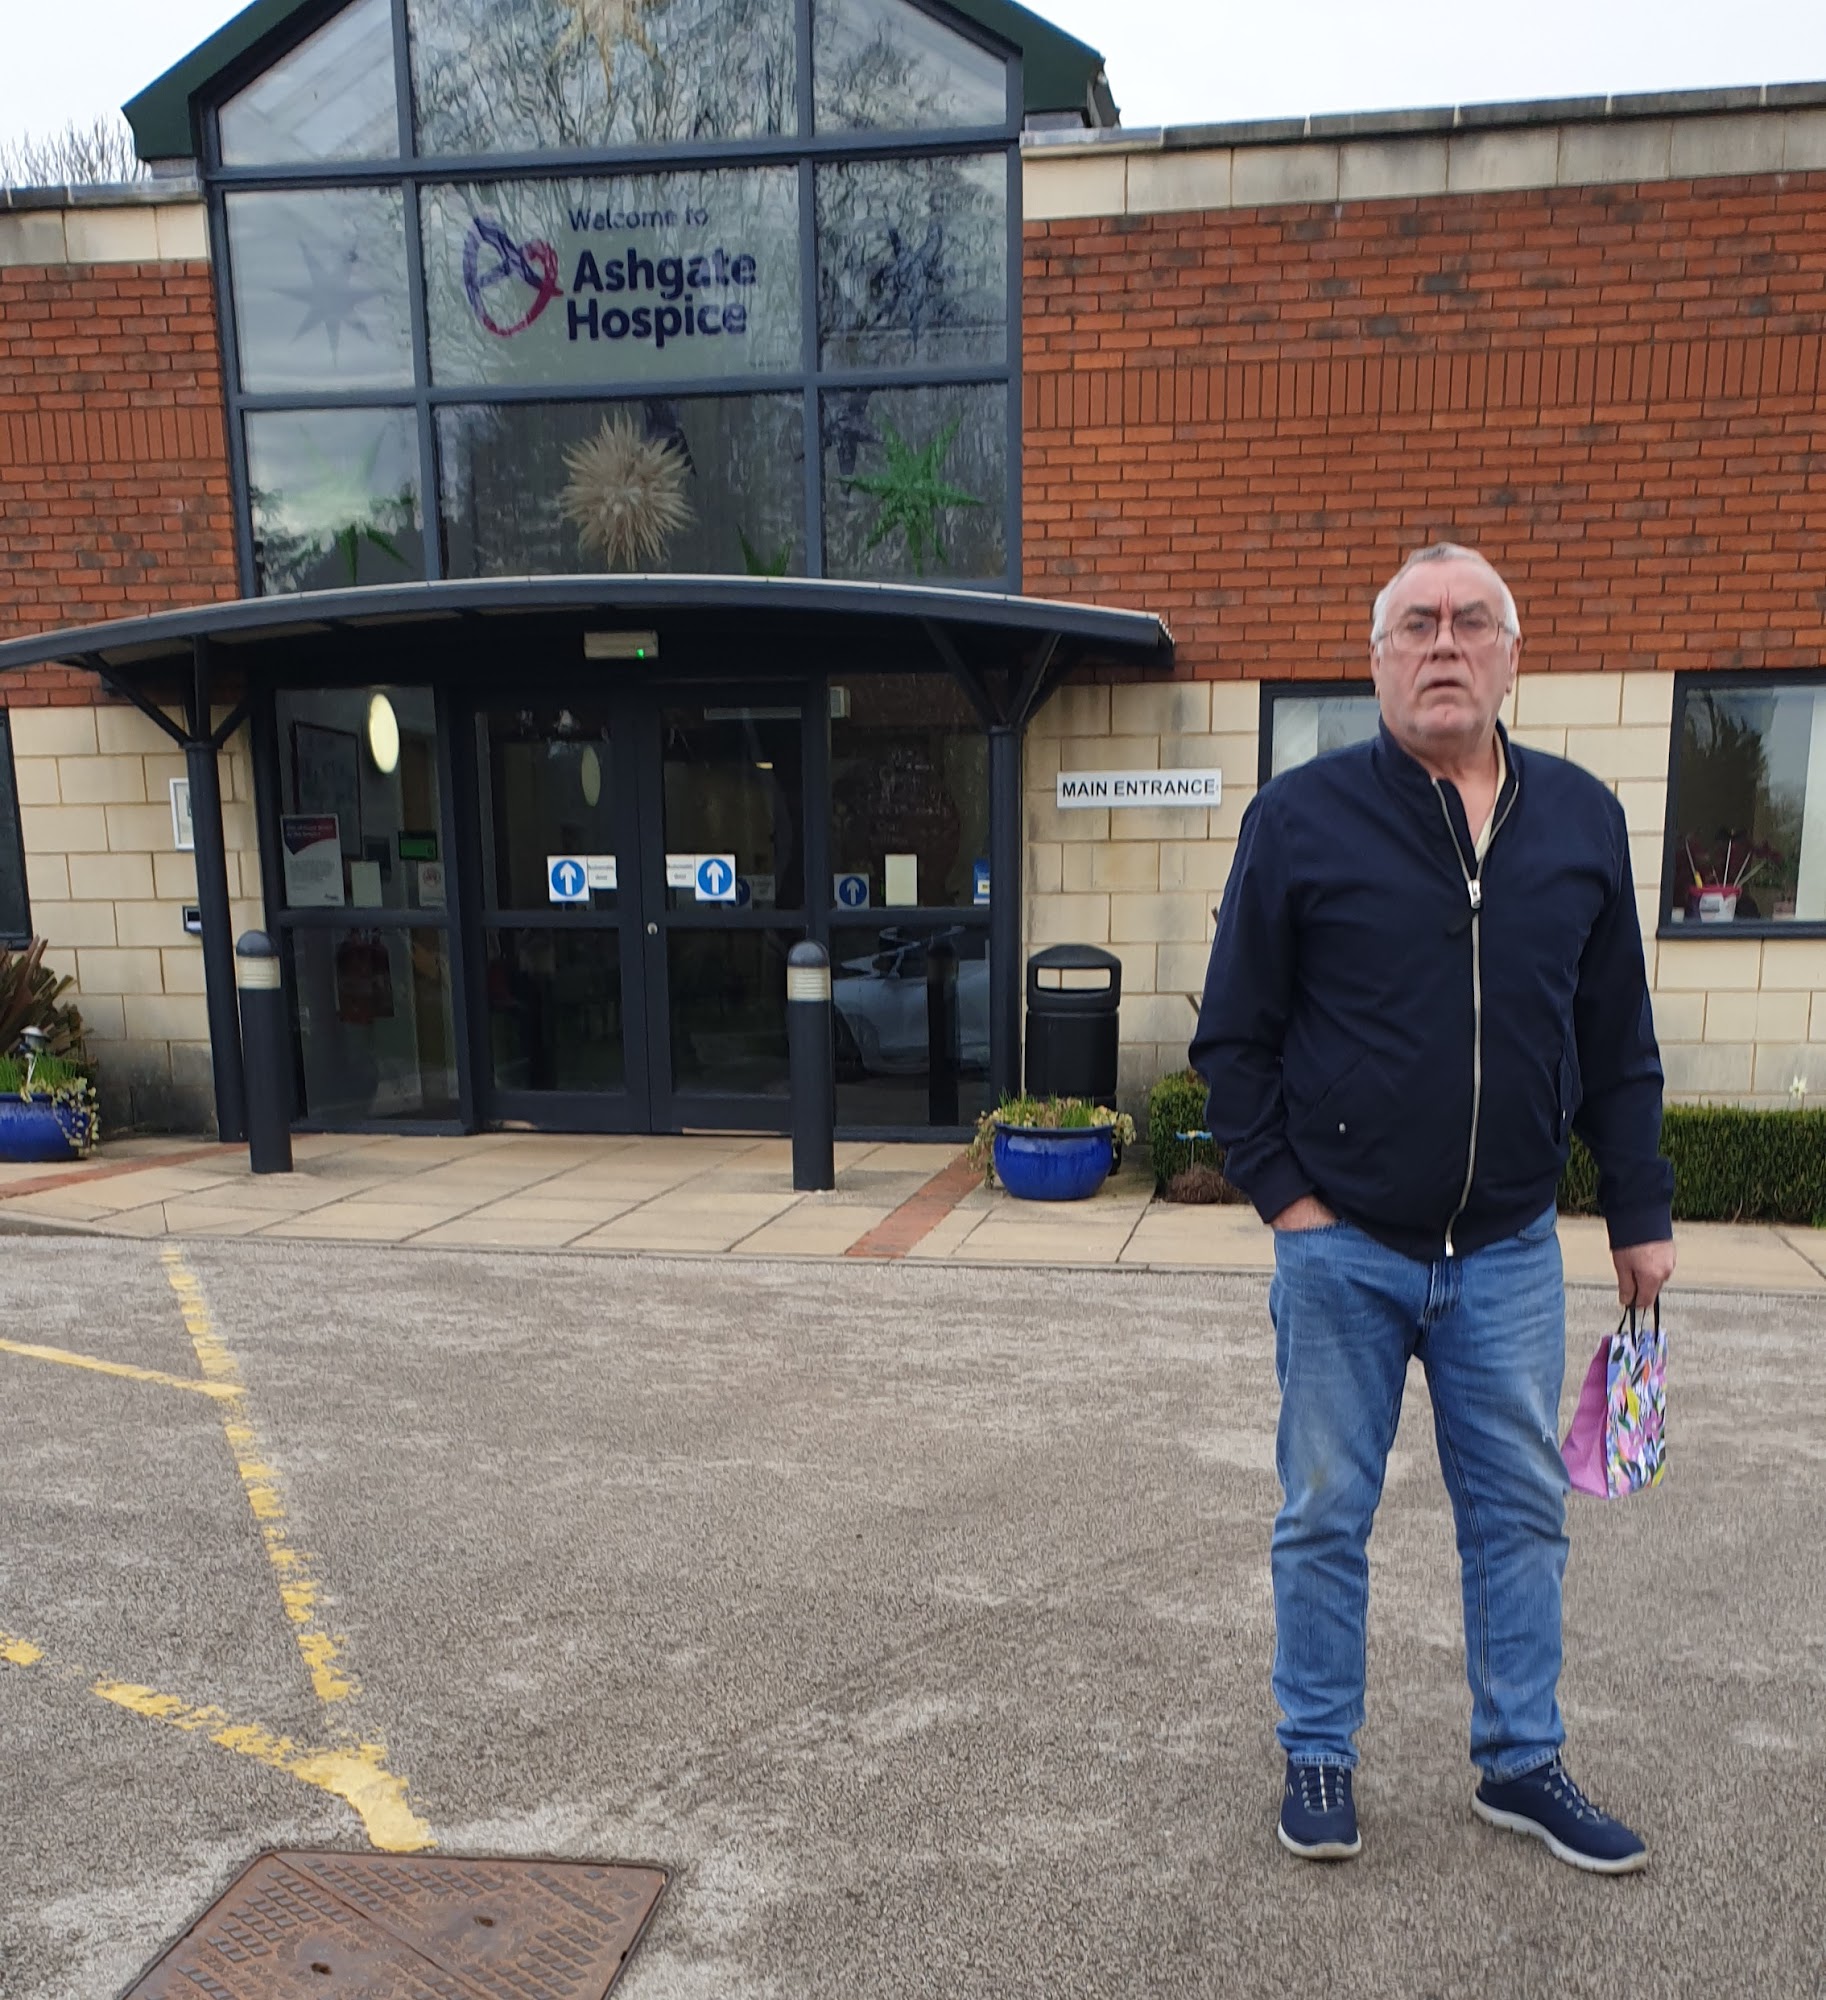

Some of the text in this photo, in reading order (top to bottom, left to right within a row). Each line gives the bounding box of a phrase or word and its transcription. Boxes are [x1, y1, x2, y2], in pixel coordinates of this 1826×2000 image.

[568, 204, 709, 232] Welcome to
[572, 247, 757, 300] Ashgate
[567, 293, 748, 349] Hospice
[1062, 778, 1216, 798] MAIN ENTRANCE
